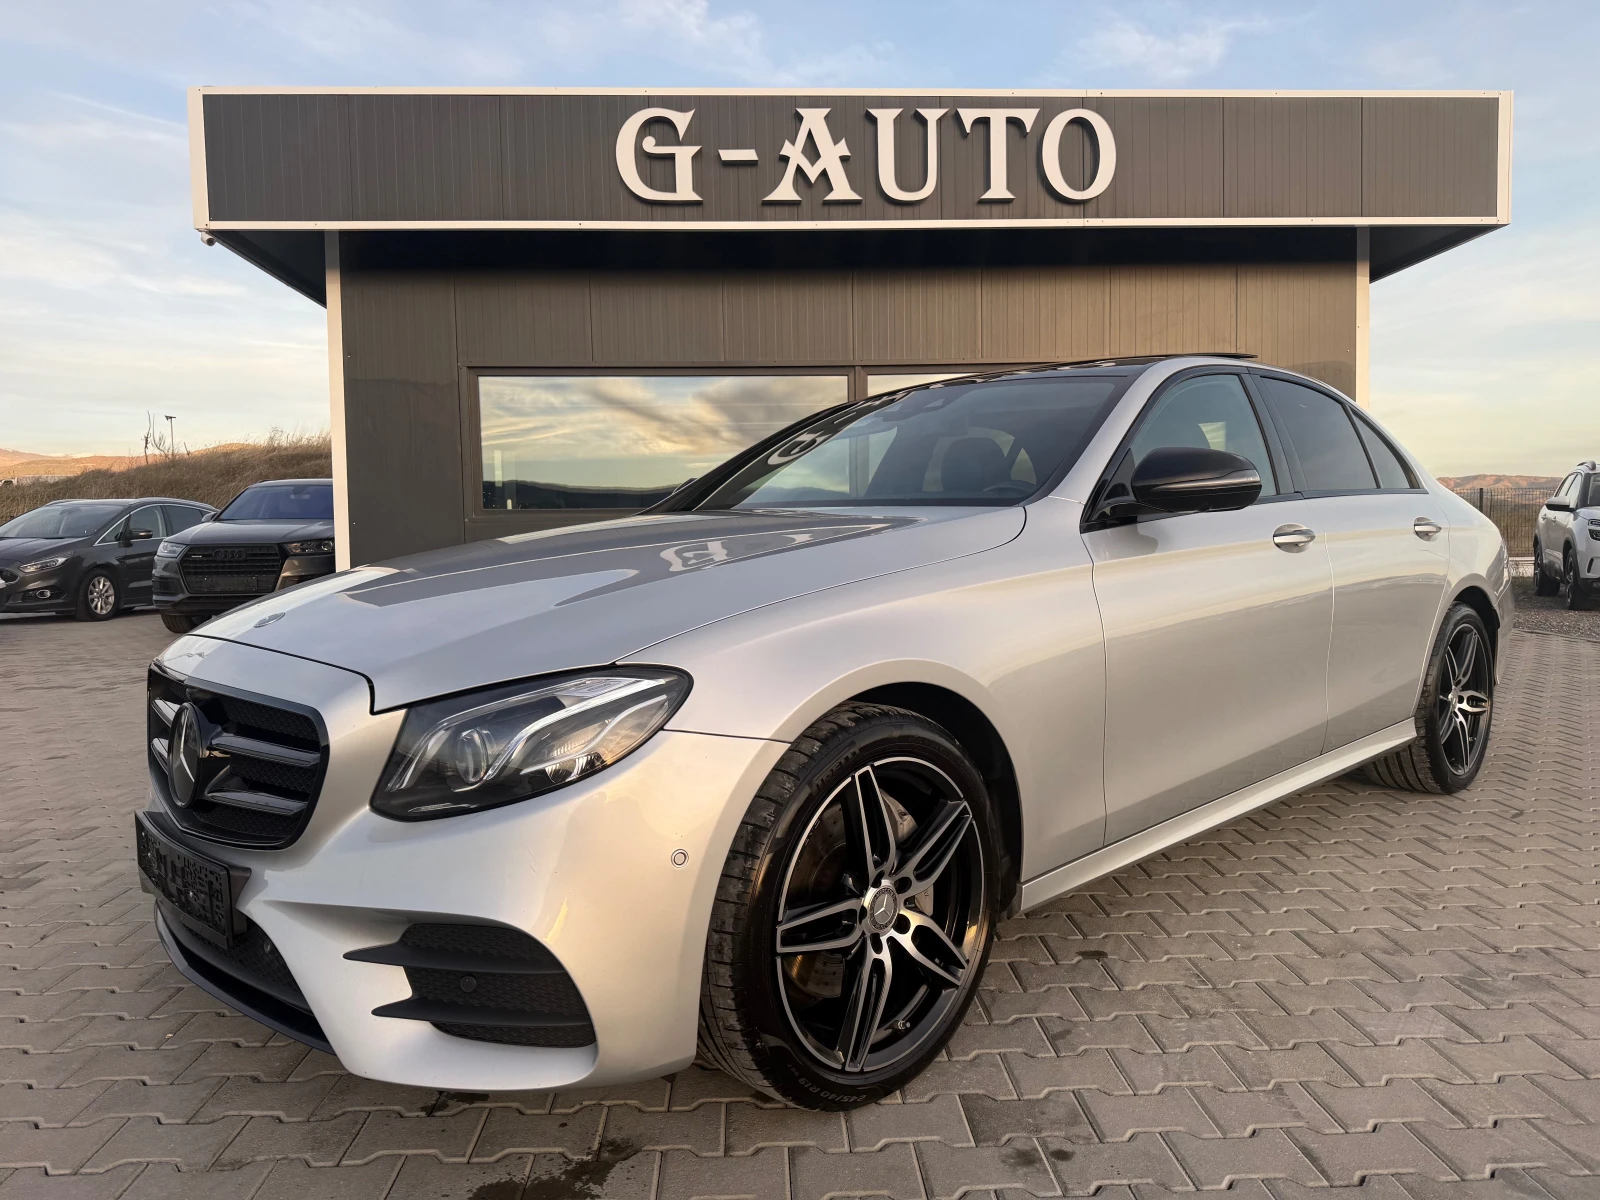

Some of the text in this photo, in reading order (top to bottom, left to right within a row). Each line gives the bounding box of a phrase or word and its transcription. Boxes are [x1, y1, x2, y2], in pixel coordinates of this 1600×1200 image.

[615, 107, 1117, 204] G-AUTO
[798, 1077, 821, 1094] R19
[820, 1091, 867, 1103] 245/40
